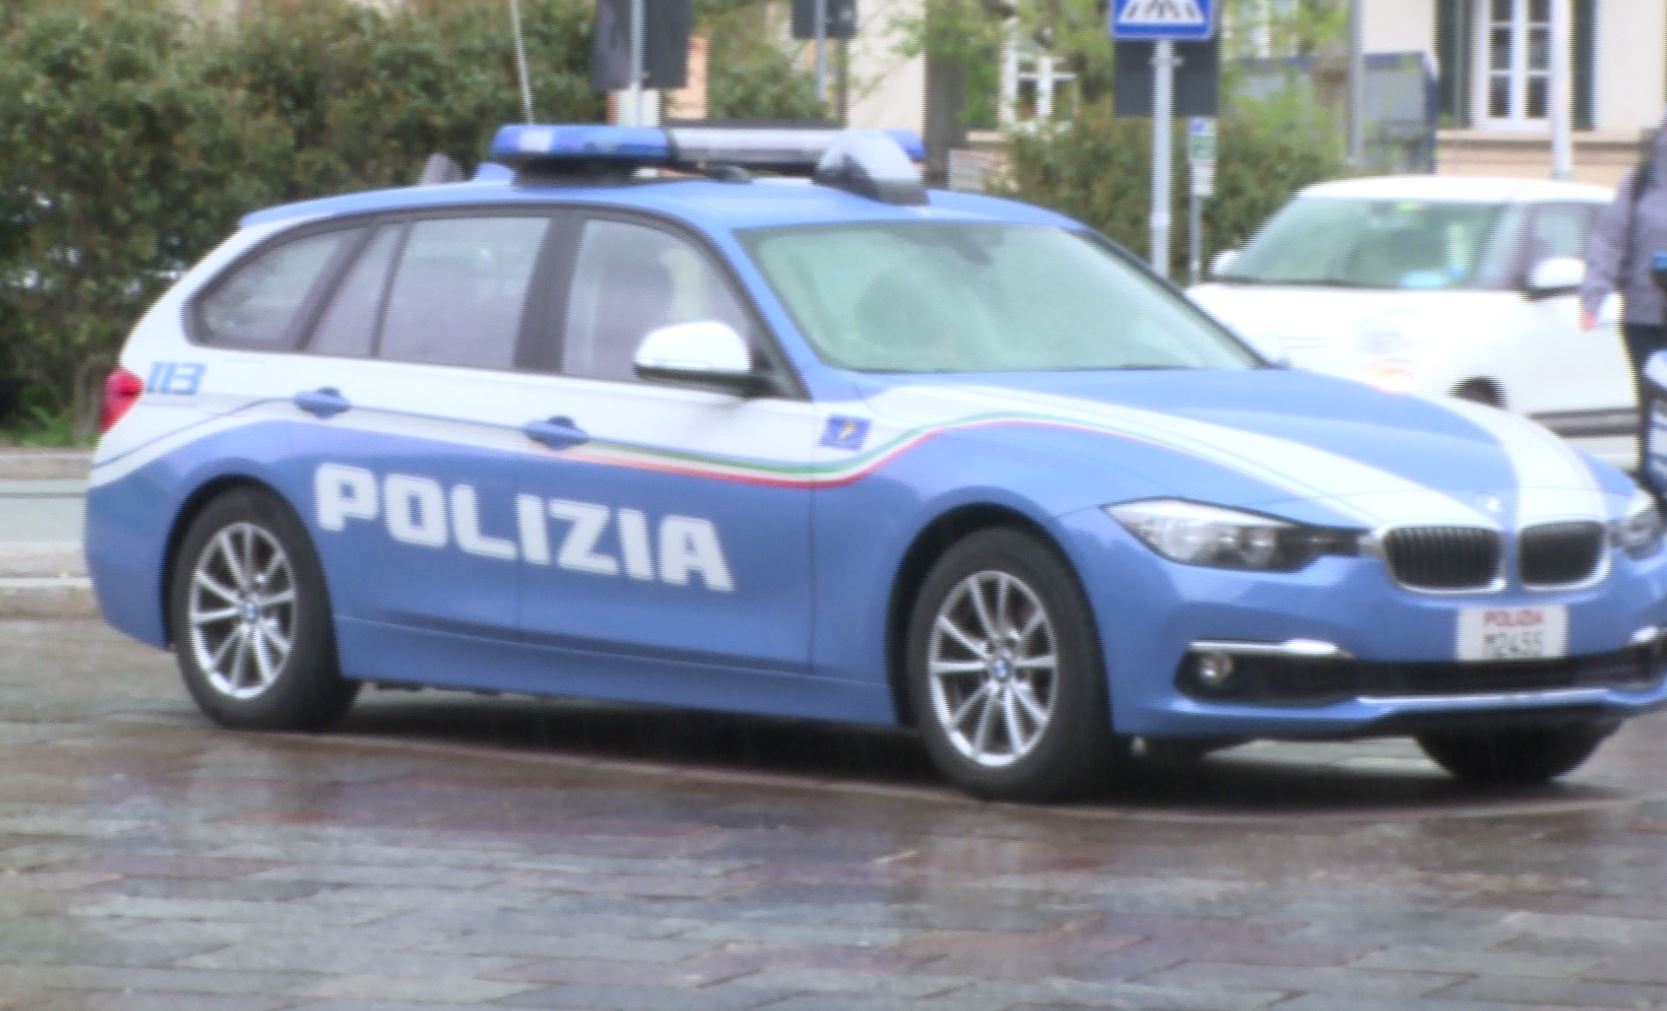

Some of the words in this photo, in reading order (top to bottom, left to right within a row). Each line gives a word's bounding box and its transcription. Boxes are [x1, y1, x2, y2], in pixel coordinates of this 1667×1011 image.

[146, 361, 207, 394] 113
[314, 462, 735, 592] POLIZIA
[1482, 608, 1544, 627] POLIZIA
